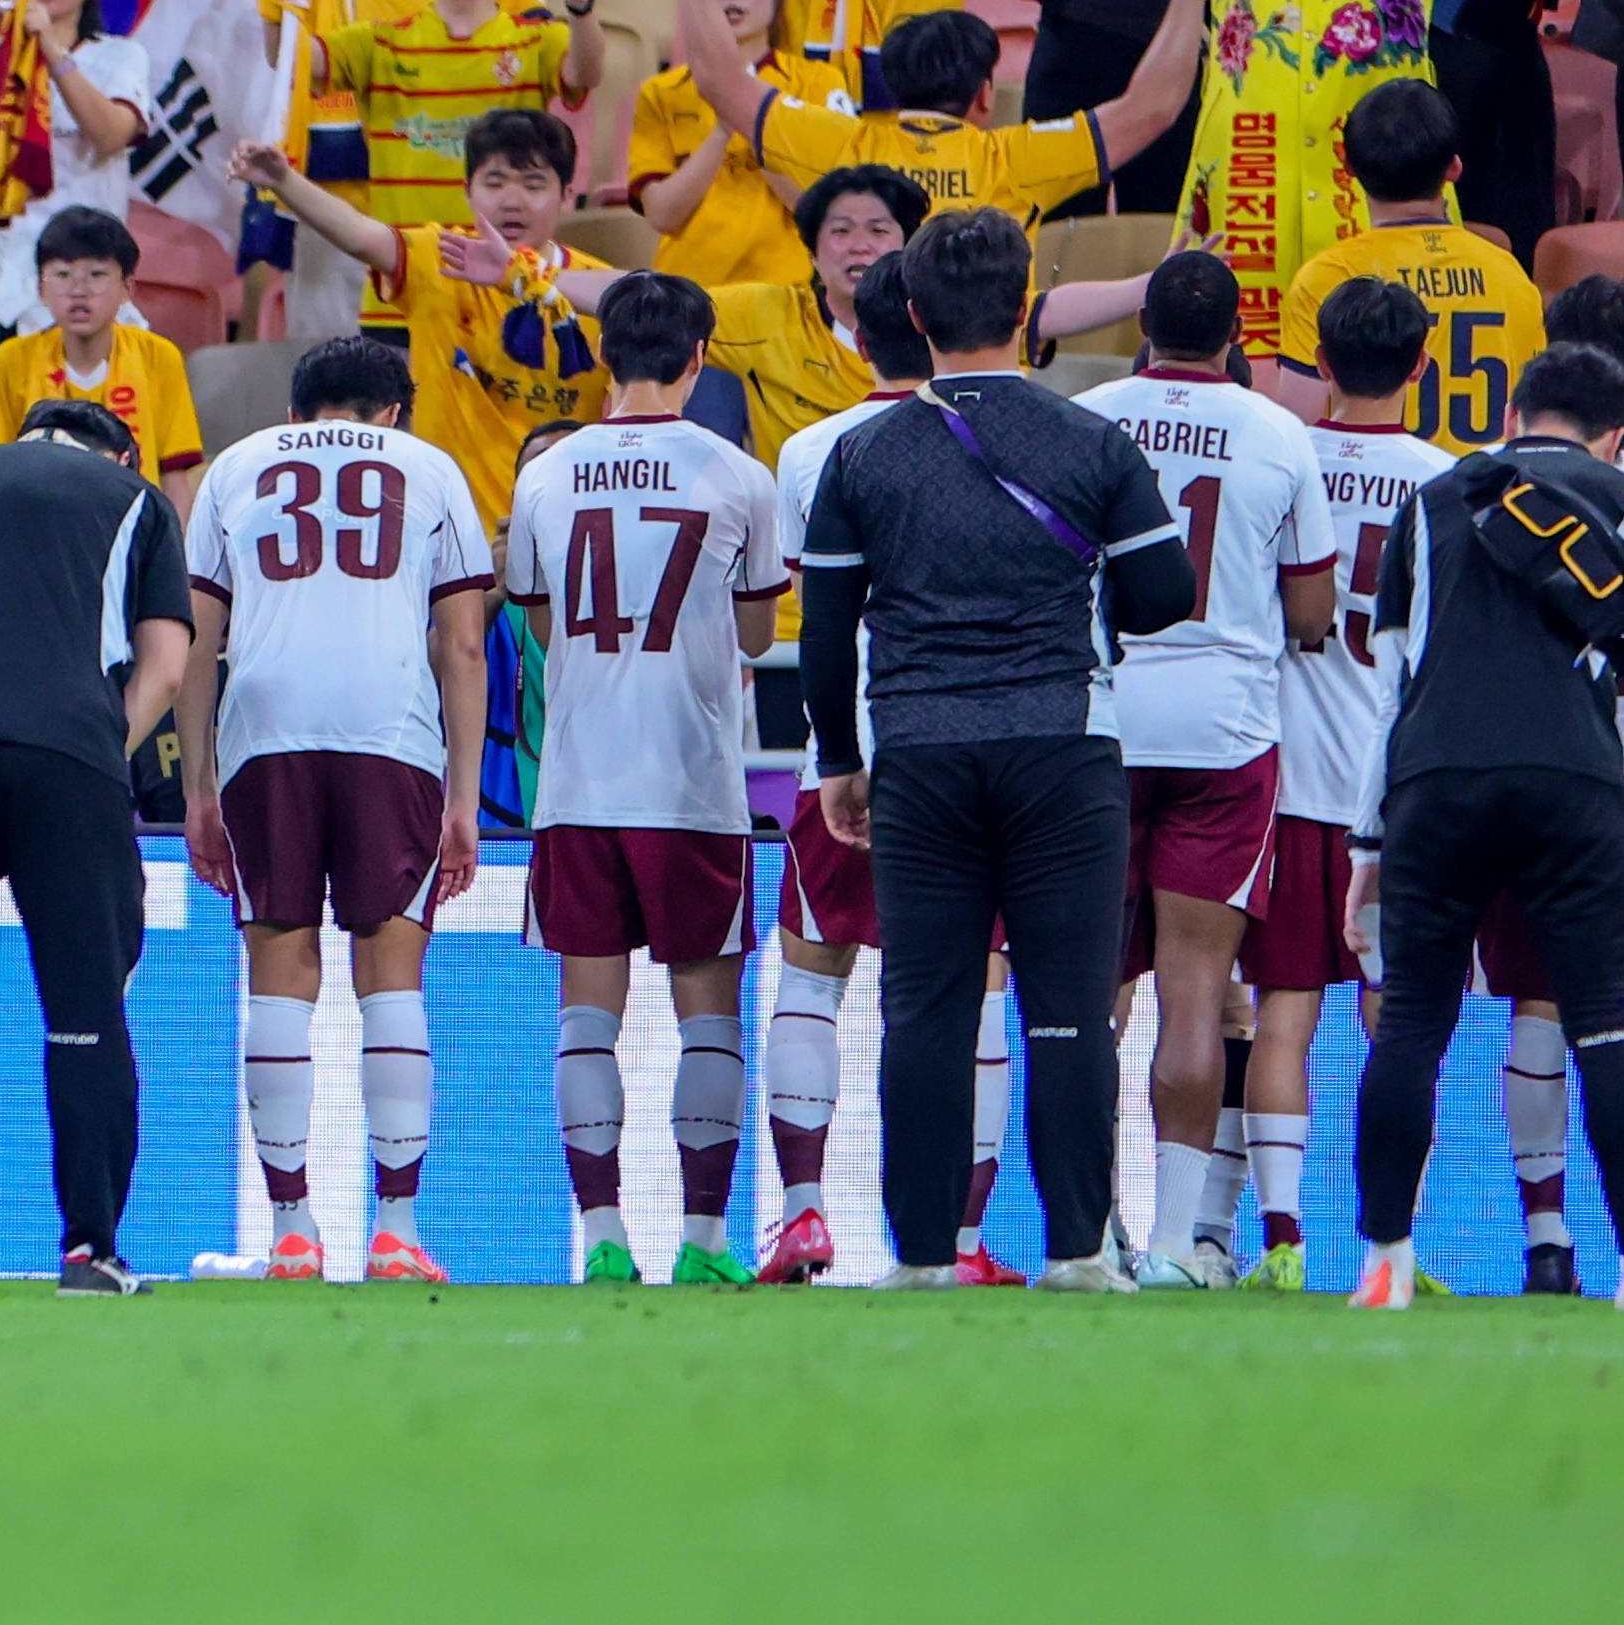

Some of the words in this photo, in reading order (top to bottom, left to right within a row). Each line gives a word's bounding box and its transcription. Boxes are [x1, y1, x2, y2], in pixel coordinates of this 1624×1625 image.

[1398, 267, 1486, 298] TAEJUN
[277, 432, 385, 453] SANGGI
[572, 459, 677, 494] HANGIL
[1322, 470, 1418, 510] NGYUN
[255, 460, 406, 582] 39
[564, 506, 709, 654] 47
